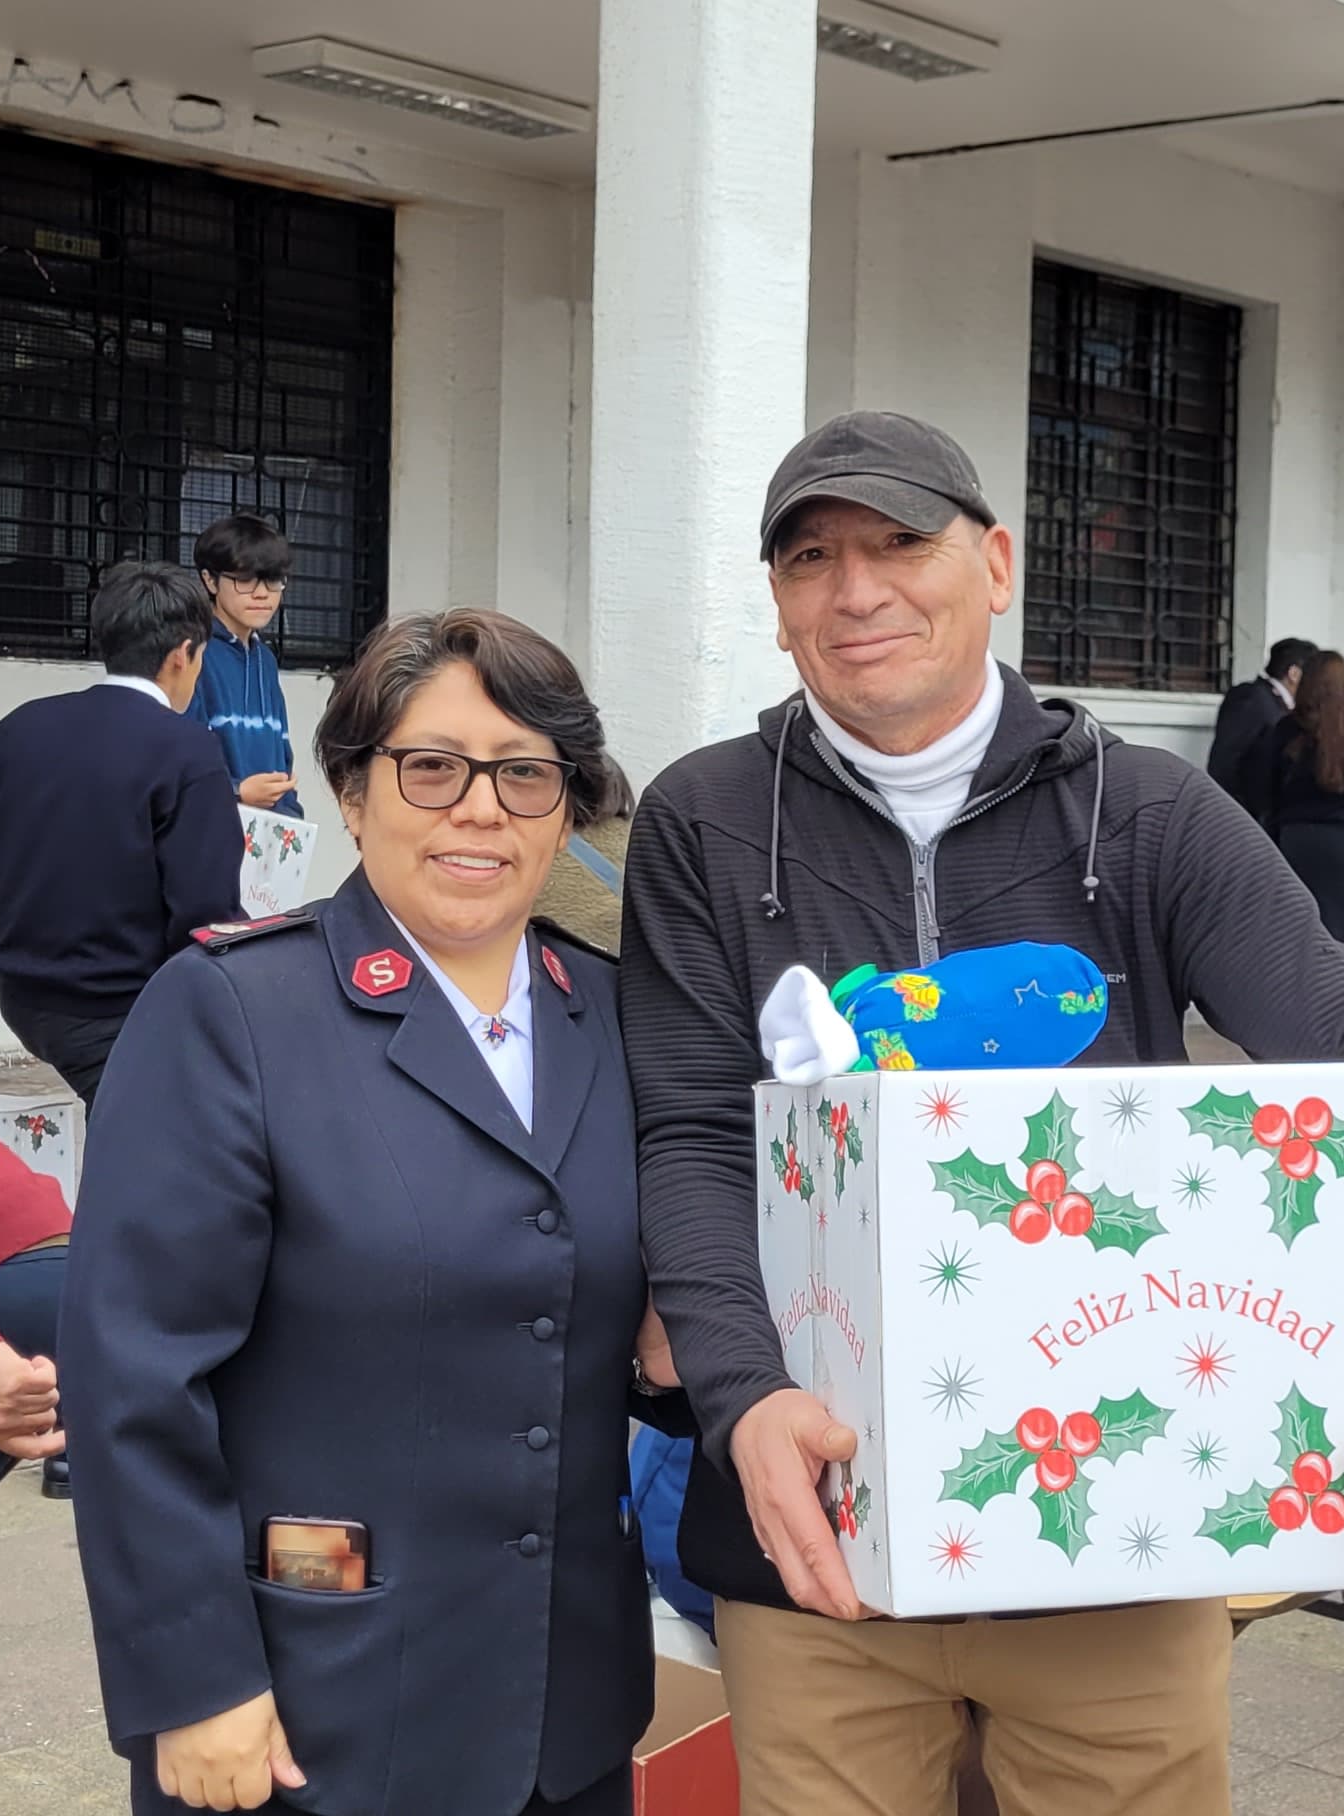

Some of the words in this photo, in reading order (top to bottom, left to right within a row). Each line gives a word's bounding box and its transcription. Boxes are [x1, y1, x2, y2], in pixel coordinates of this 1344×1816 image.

[368, 957, 397, 988] S
[778, 1288, 810, 1354] Feliz
[808, 1272, 865, 1374] Navidad
[1027, 1292, 1134, 1370] Feliz
[1141, 1268, 1336, 1360] Navidad
